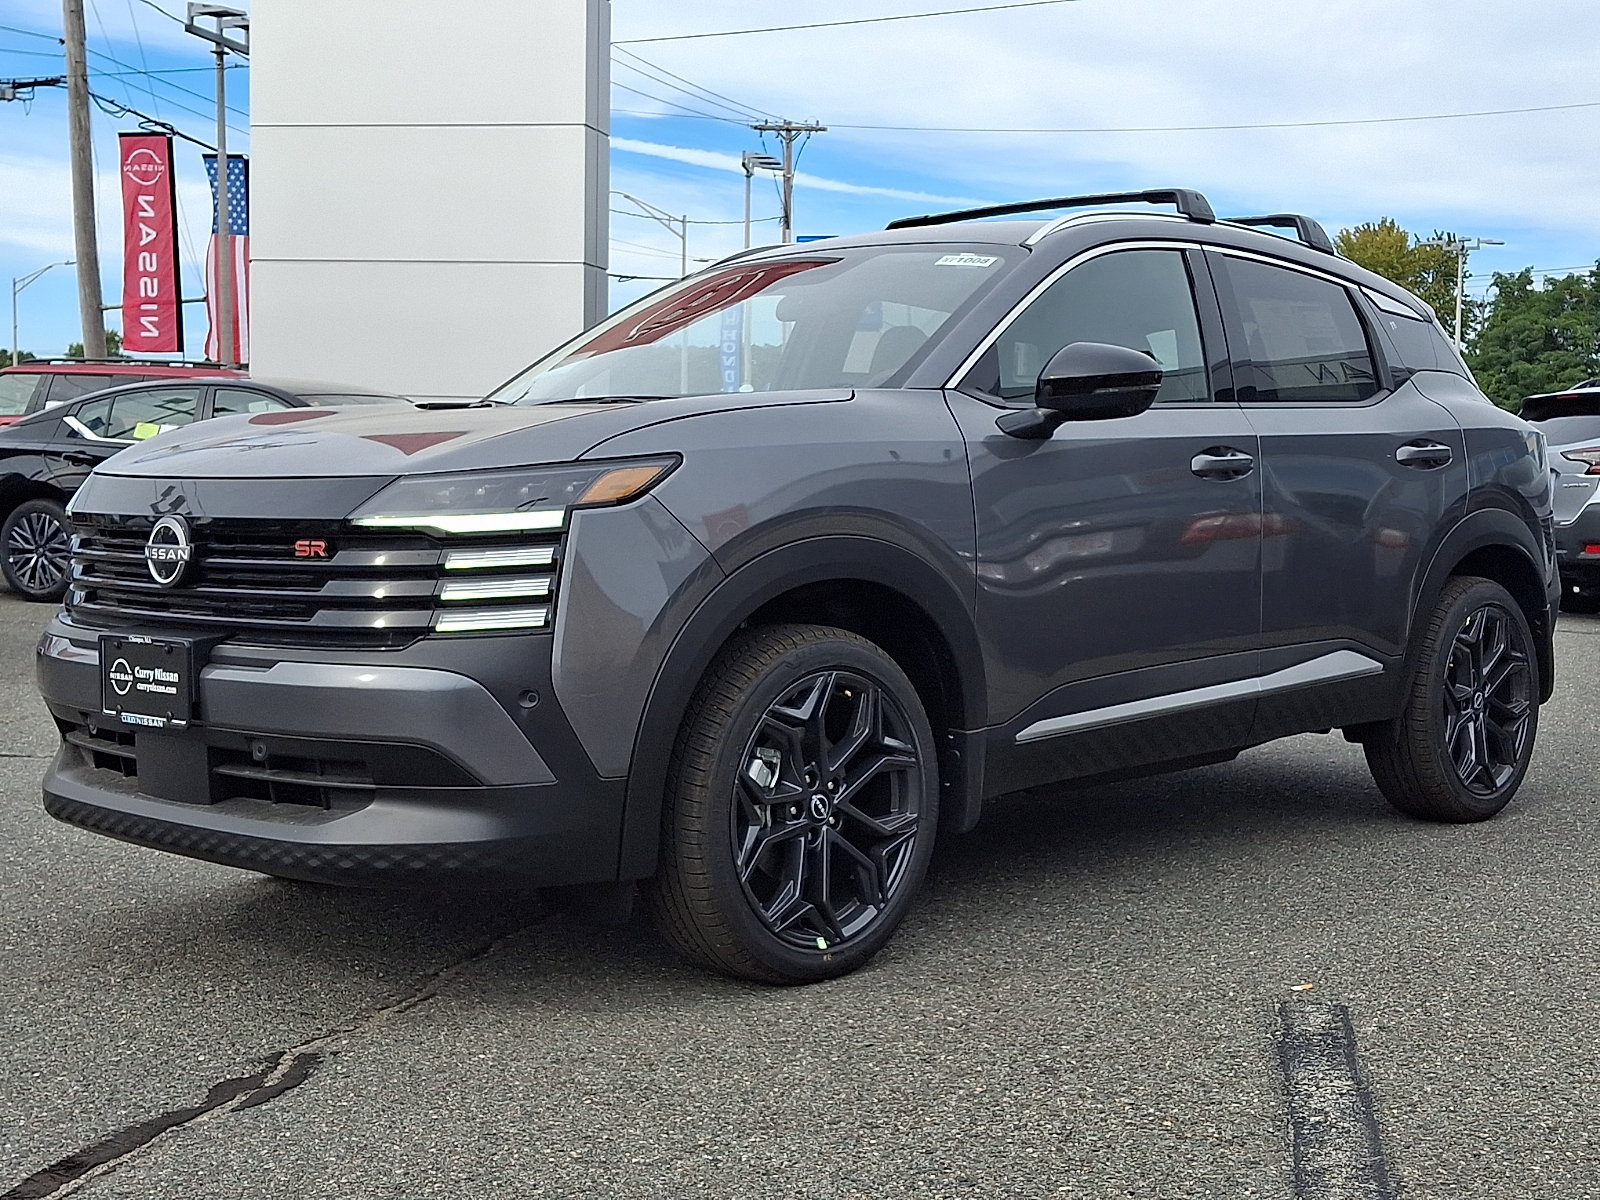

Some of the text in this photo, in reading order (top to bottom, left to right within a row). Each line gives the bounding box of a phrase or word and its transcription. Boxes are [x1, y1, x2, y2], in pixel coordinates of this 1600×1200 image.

[144, 546, 189, 560] NISSAN
[294, 540, 328, 557] SR
[110, 672, 133, 681] NISSAN
[134, 666, 179, 683] Curry Nissan
